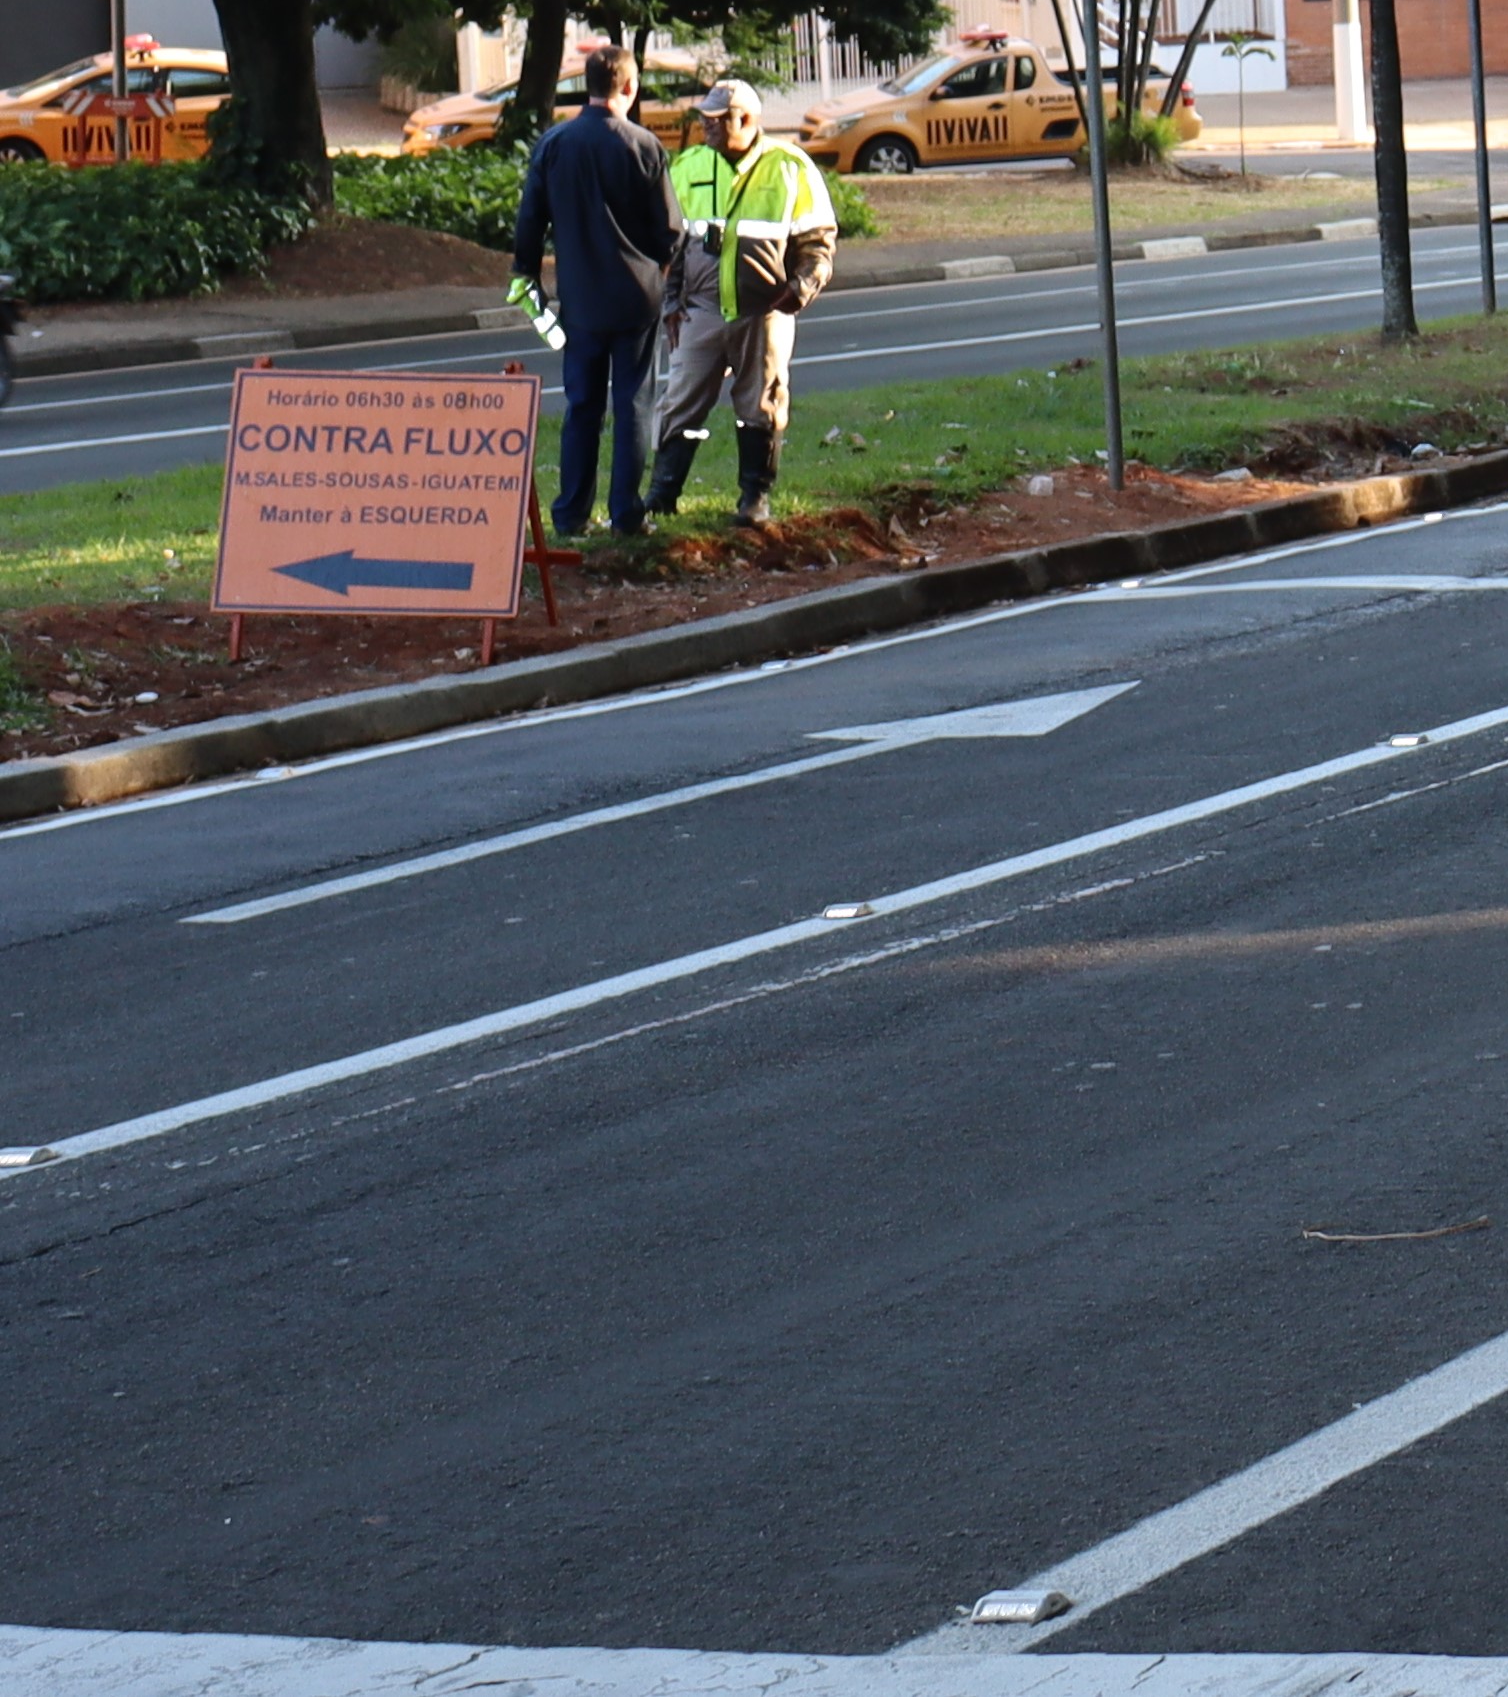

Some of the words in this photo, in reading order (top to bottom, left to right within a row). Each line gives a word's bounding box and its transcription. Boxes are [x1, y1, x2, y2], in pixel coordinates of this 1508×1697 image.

[267, 389, 339, 407] Horário
[346, 391, 404, 407] 06h30
[412, 393, 435, 409] às
[443, 392, 504, 410] 08h00
[238, 424, 394, 454] CONTRA
[404, 428, 529, 456] FLUXO
[260, 505, 332, 524] Manter
[340, 506, 352, 524] à
[360, 506, 489, 525] ESQUERDA
